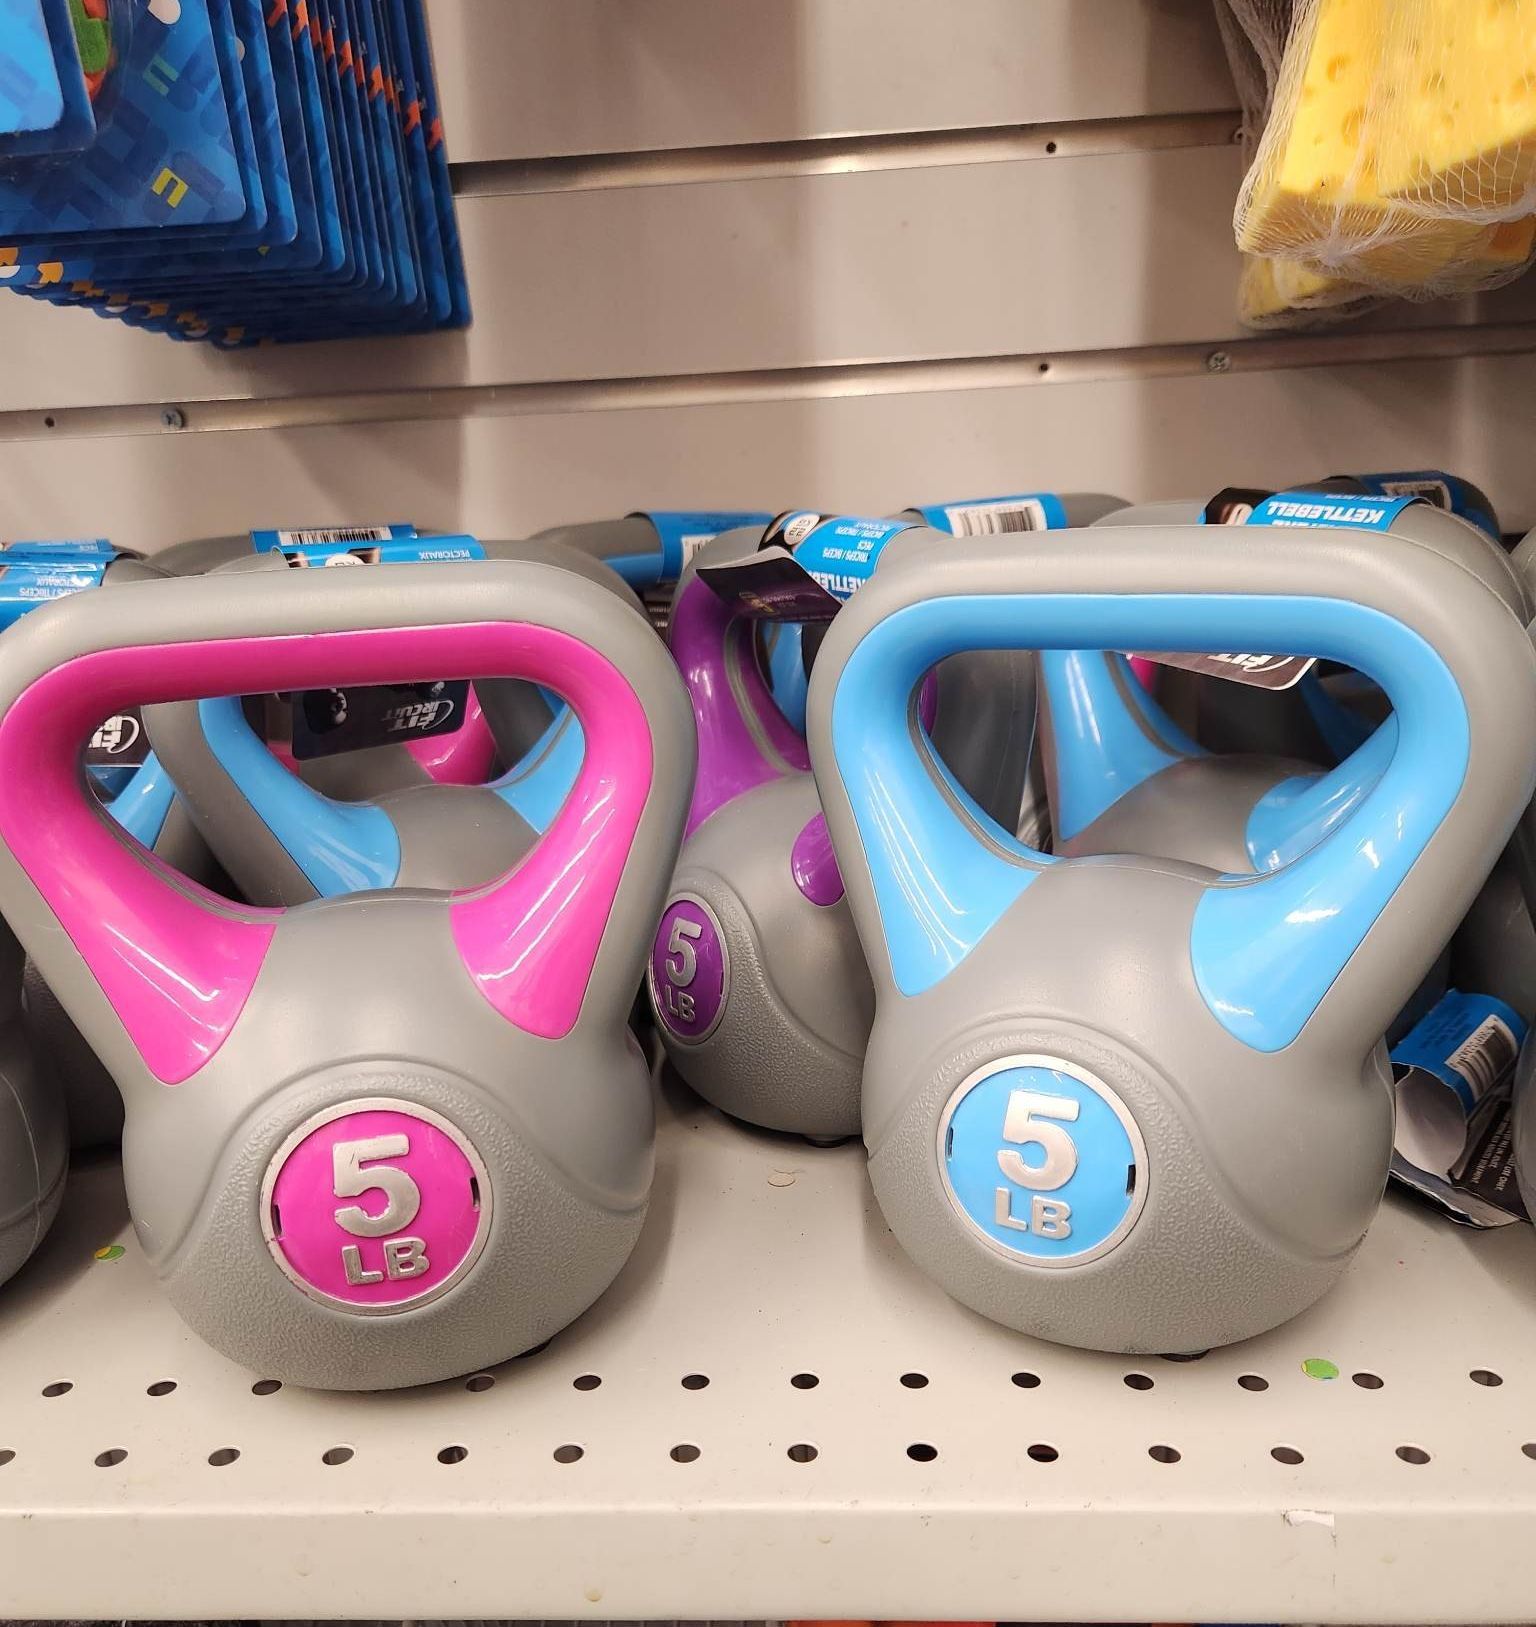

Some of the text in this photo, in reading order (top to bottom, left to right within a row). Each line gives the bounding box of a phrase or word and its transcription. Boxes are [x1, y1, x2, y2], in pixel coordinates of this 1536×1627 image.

[1267, 501, 1385, 524] KETTLEBELL
[419, 549, 471, 560] PECTORAUX
[823, 548, 843, 559] BICEPS
[846, 550, 868, 562] TRICEPS
[387, 712, 437, 732] FIT
[666, 916, 702, 987] 5
[665, 984, 696, 1022] LB
[997, 1089, 1080, 1191] 5
[333, 1133, 421, 1238] 5
[995, 1187, 1073, 1241] LB
[341, 1237, 431, 1286] LB
